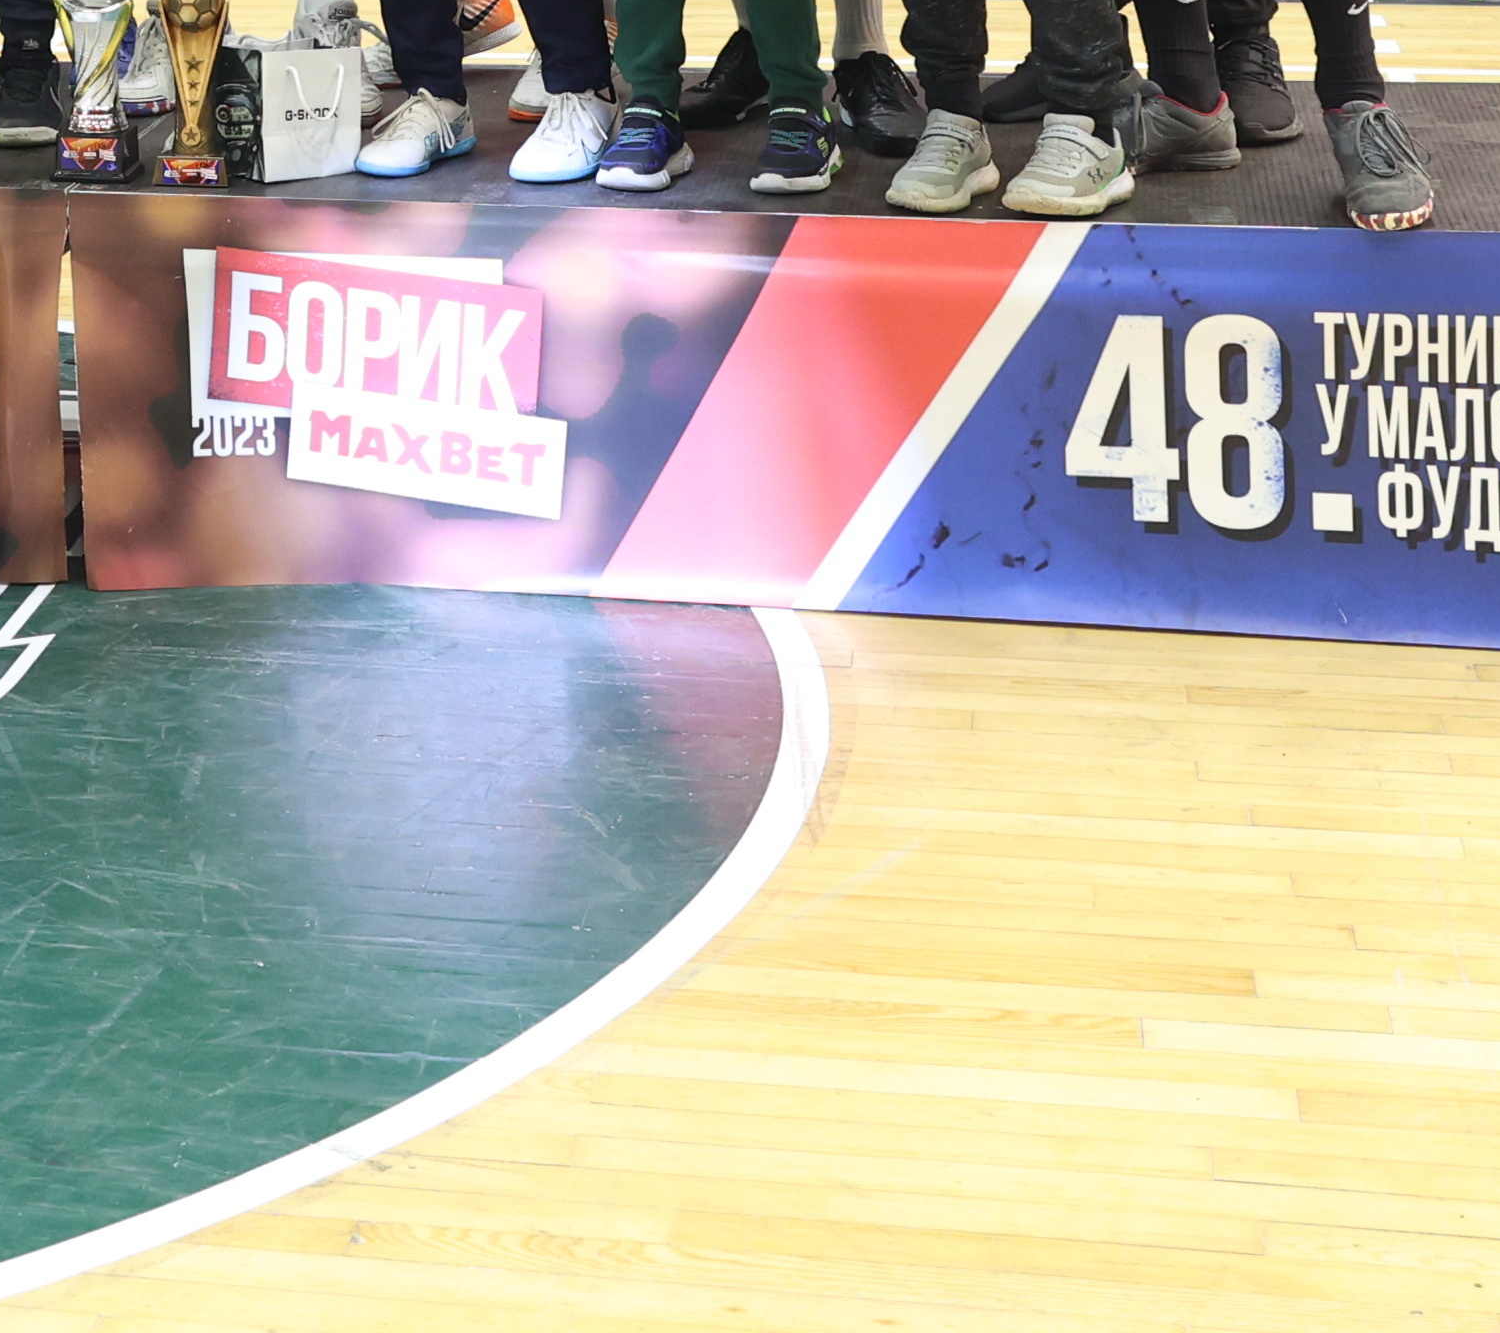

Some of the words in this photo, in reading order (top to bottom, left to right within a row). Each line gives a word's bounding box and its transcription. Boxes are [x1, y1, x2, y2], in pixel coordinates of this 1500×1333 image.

[226, 269, 528, 415] БОРИК
[191, 415, 278, 457] 2023
[308, 409, 547, 487] MAXBET
[1314, 382, 1350, 457] У
